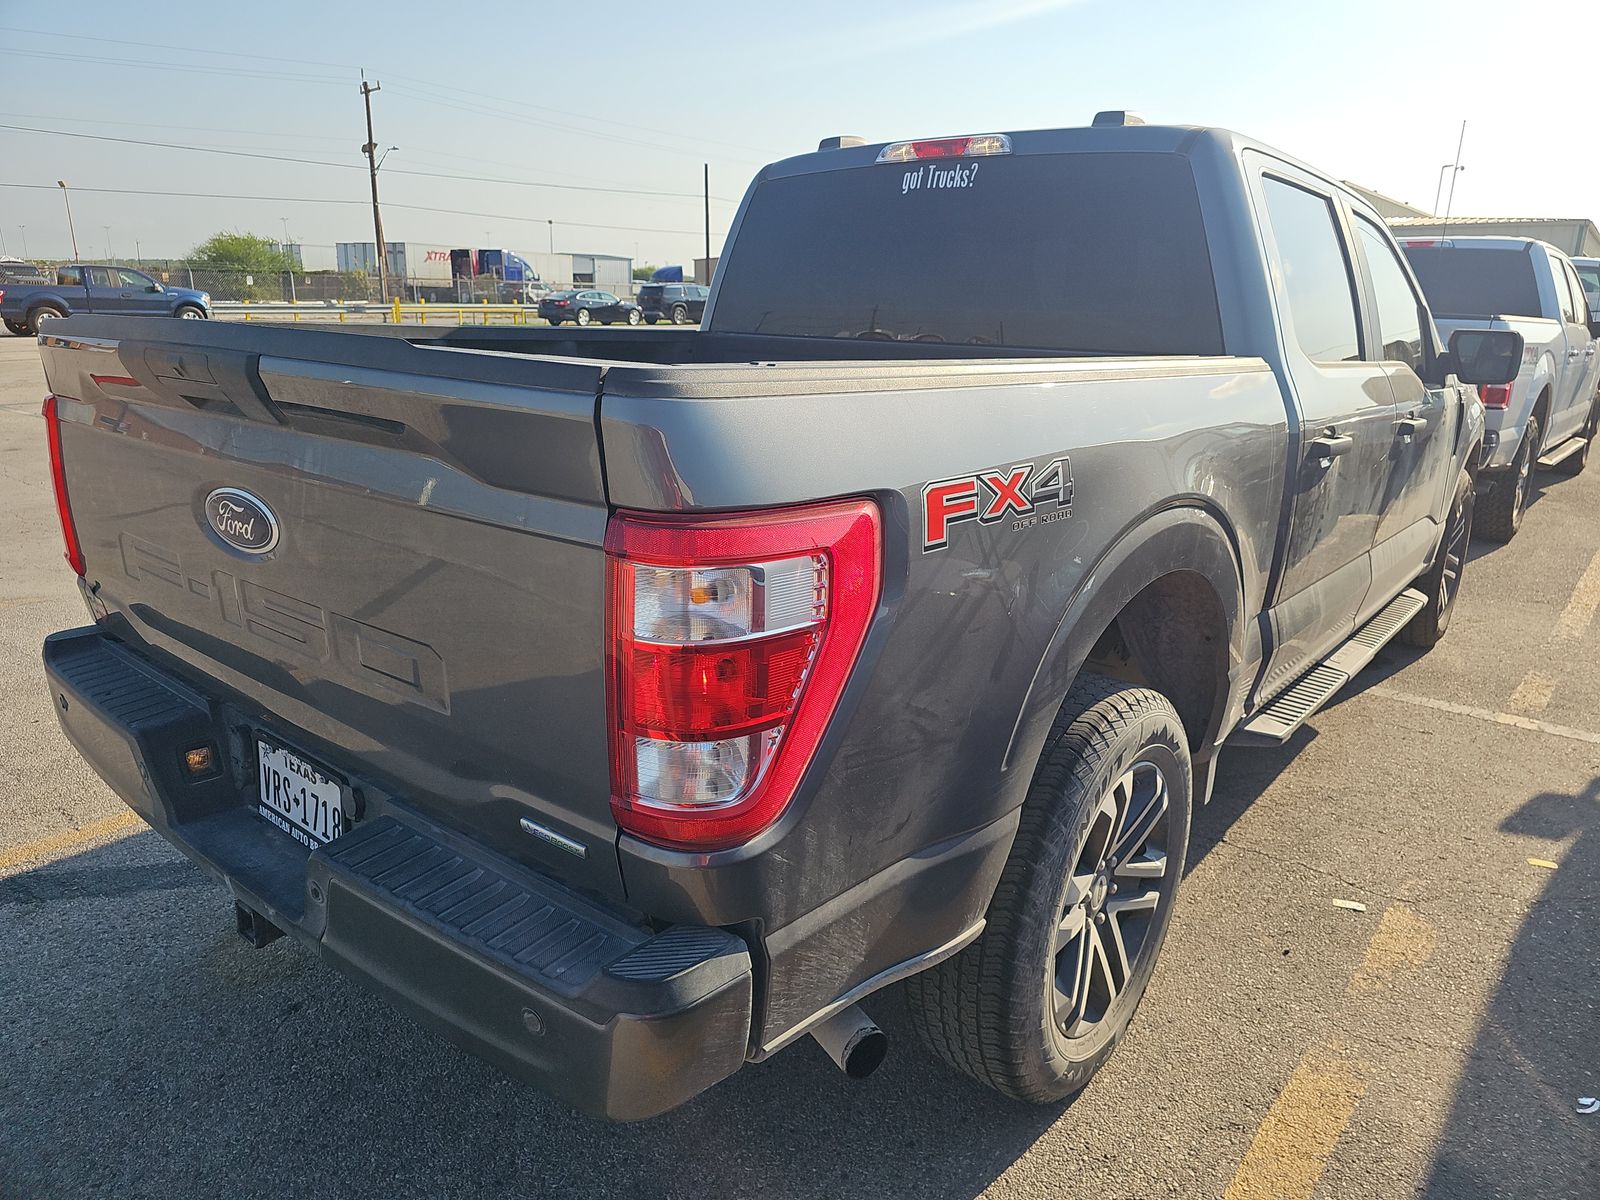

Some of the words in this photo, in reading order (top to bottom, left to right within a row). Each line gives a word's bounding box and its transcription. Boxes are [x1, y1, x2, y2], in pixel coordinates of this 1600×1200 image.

[902, 166, 924, 194] got
[927, 162, 979, 189] Trucks?
[217, 500, 255, 541] Ford
[921, 456, 1074, 554] FX4
[1012, 519, 1037, 532] OFF
[1040, 508, 1073, 525] ROAD
[283, 755, 317, 785] TEXAS
[258, 804, 291, 835] AMERICAN
[290, 826, 309, 847] AUTO
